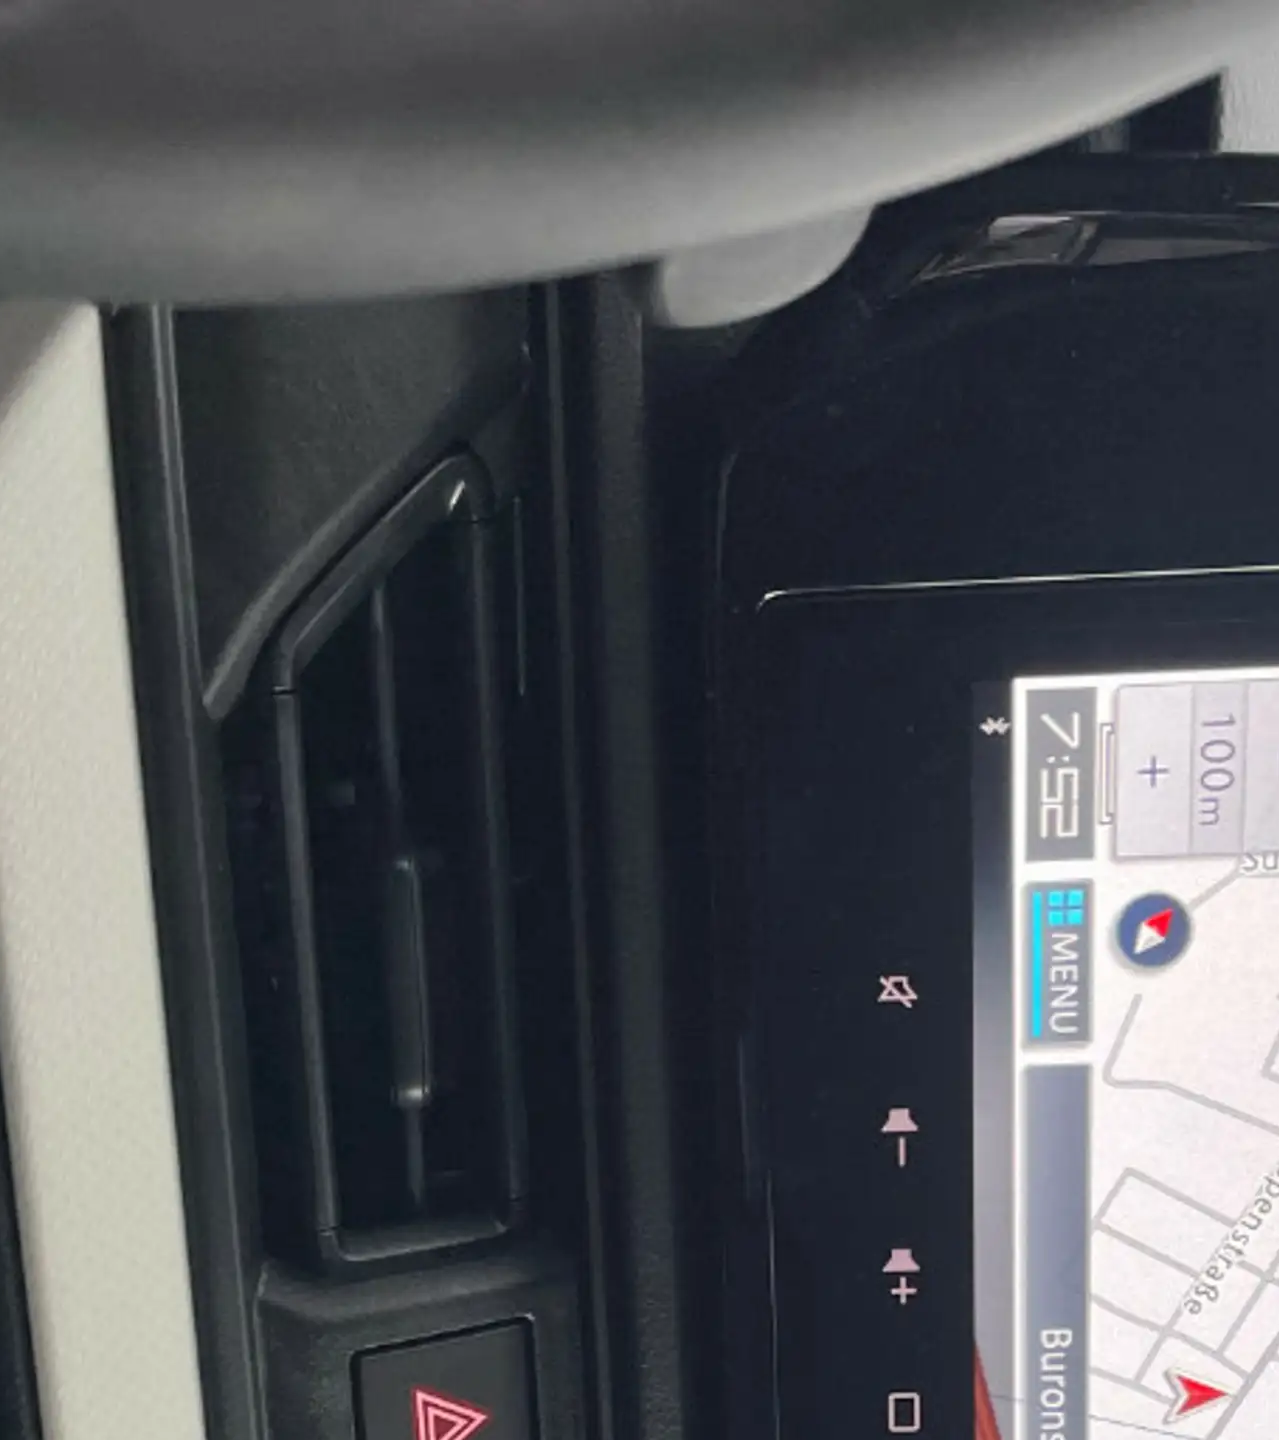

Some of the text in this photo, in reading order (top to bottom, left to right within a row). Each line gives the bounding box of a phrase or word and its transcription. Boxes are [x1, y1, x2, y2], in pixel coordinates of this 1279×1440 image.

[1040, 711, 1080, 838] 7:52
[1199, 713, 1237, 826] 100m
[1049, 932, 1079, 1033] MENU
